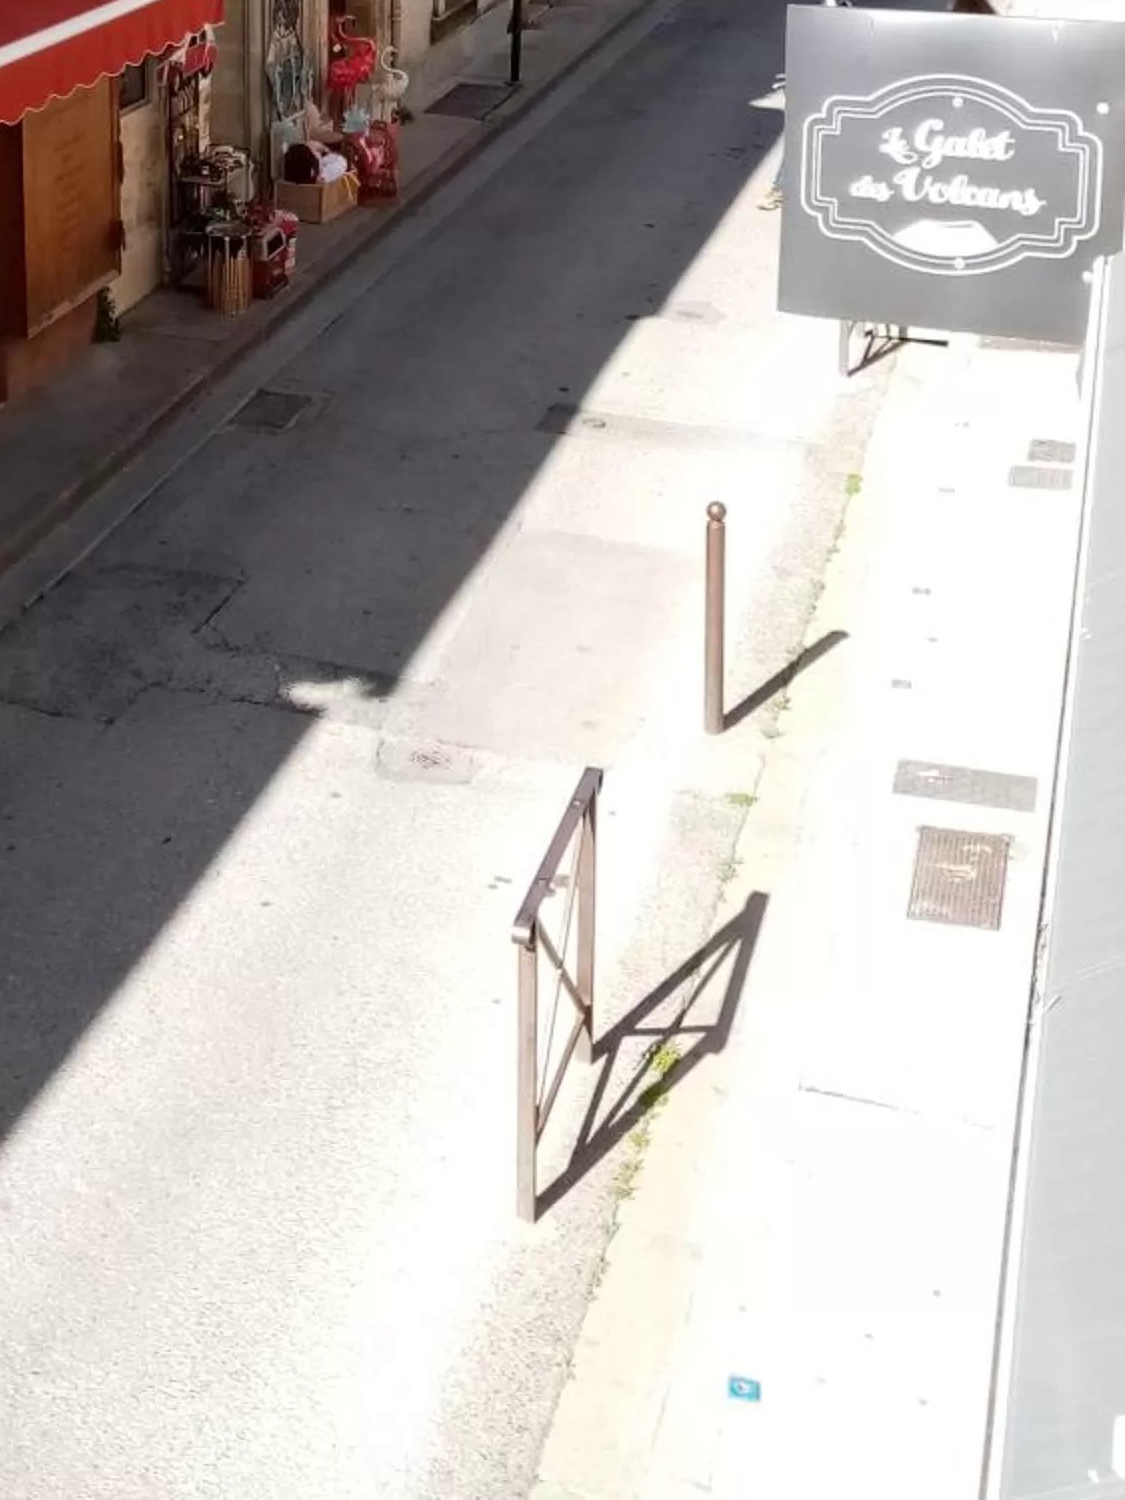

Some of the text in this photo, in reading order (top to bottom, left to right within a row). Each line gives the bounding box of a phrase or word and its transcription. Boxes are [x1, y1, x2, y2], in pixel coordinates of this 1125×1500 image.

[915, 118, 1016, 169] Galet
[849, 166, 1047, 216] des Volcans
